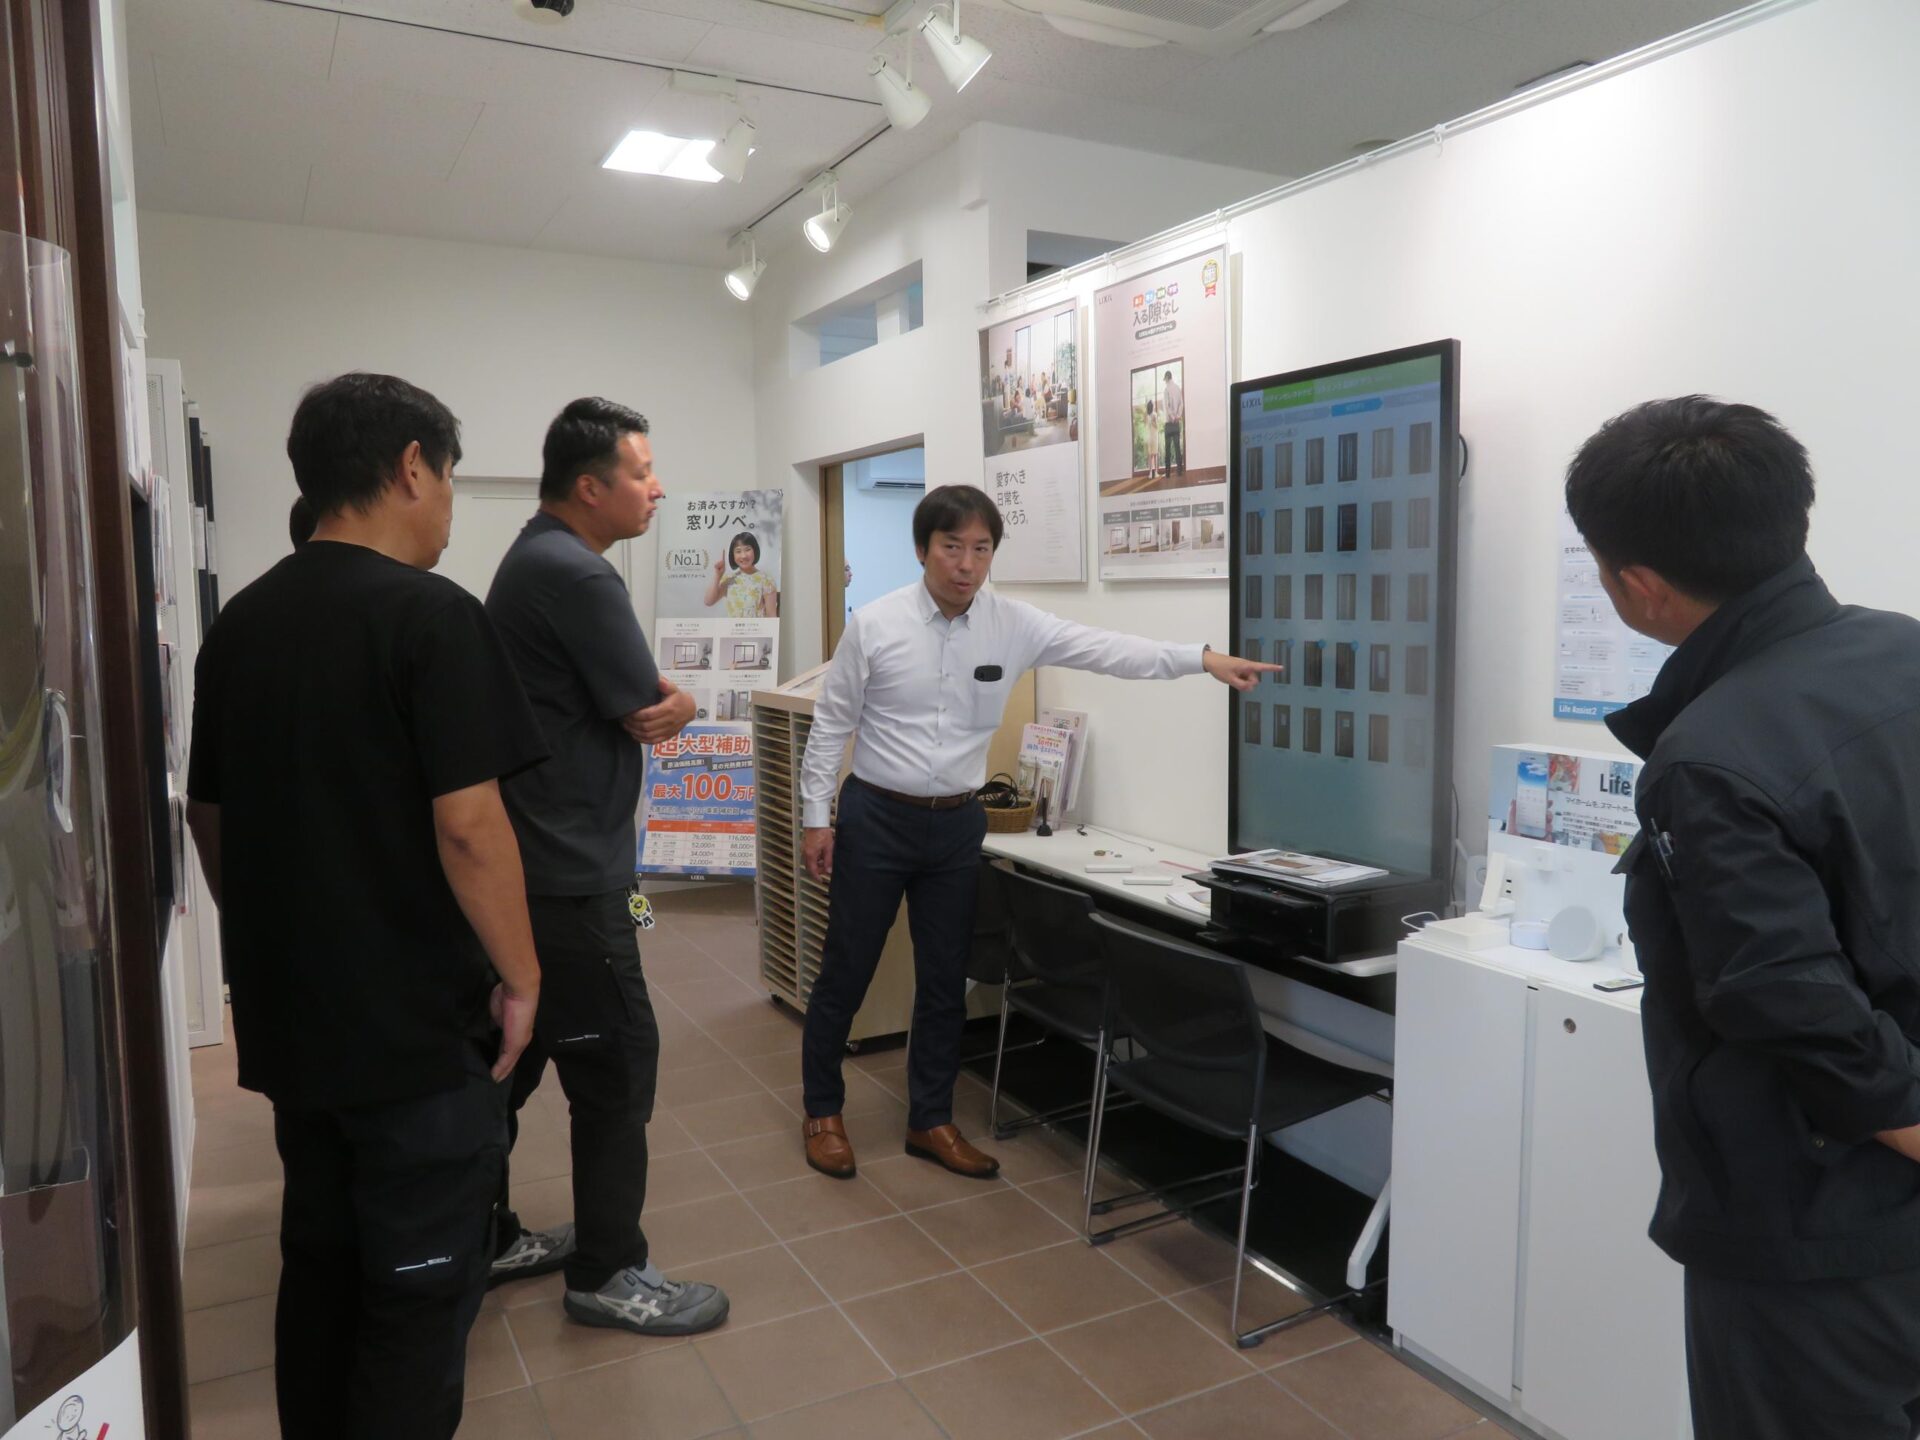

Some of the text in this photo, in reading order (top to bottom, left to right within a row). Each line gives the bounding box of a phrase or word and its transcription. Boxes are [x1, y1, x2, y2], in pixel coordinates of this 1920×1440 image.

[1099, 294, 1112, 305] LIXIL
[1133, 299, 1179, 327] 入る隙なし
[1242, 398, 1262, 409] LIXIL
[996, 469, 1026, 488] 愛すべき
[686, 514, 755, 531] 窓リノベ。
[674, 553, 701, 566] No.1
[1600, 773, 1632, 795] Life
